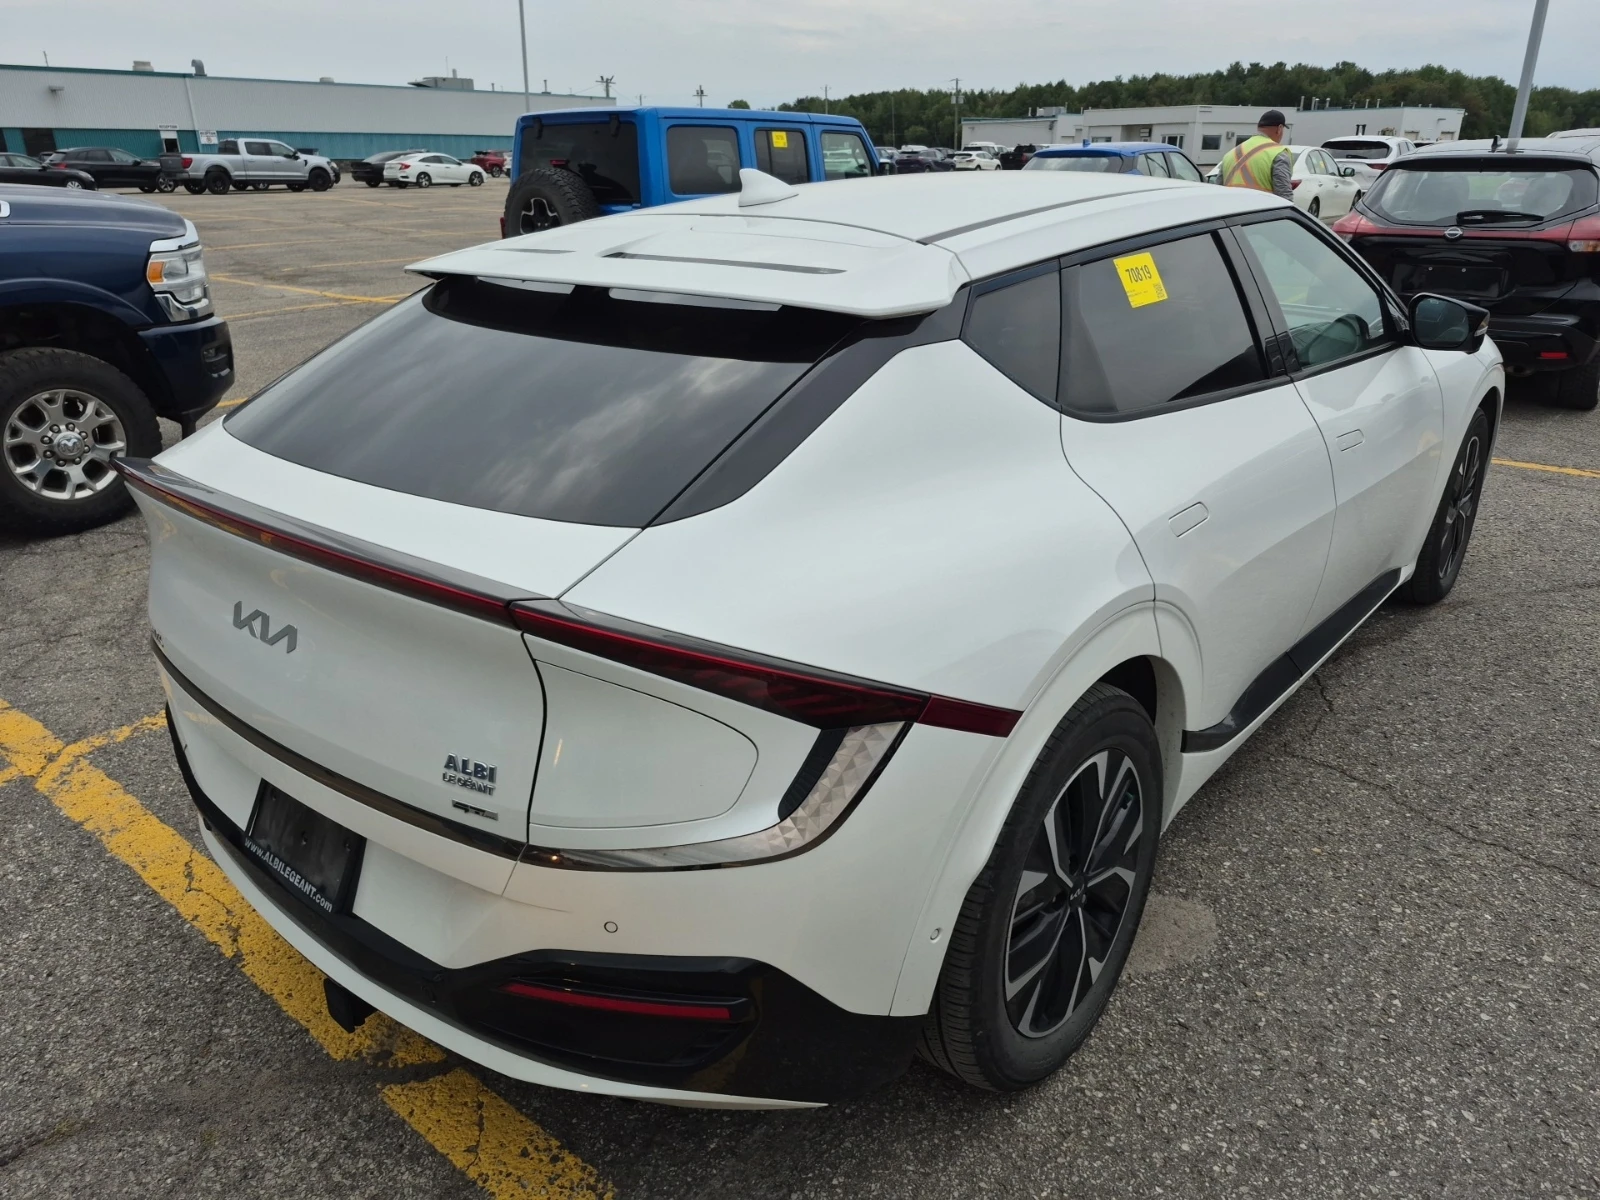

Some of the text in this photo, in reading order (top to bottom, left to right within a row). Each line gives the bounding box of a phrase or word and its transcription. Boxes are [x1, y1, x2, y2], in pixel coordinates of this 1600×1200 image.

[1125, 264, 1152, 284] 70819
[233, 600, 298, 654] KIA
[442, 771, 457, 785] LE
[444, 752, 497, 784] ALBI
[244, 837, 334, 913] www.ALBILEGEANT.com
